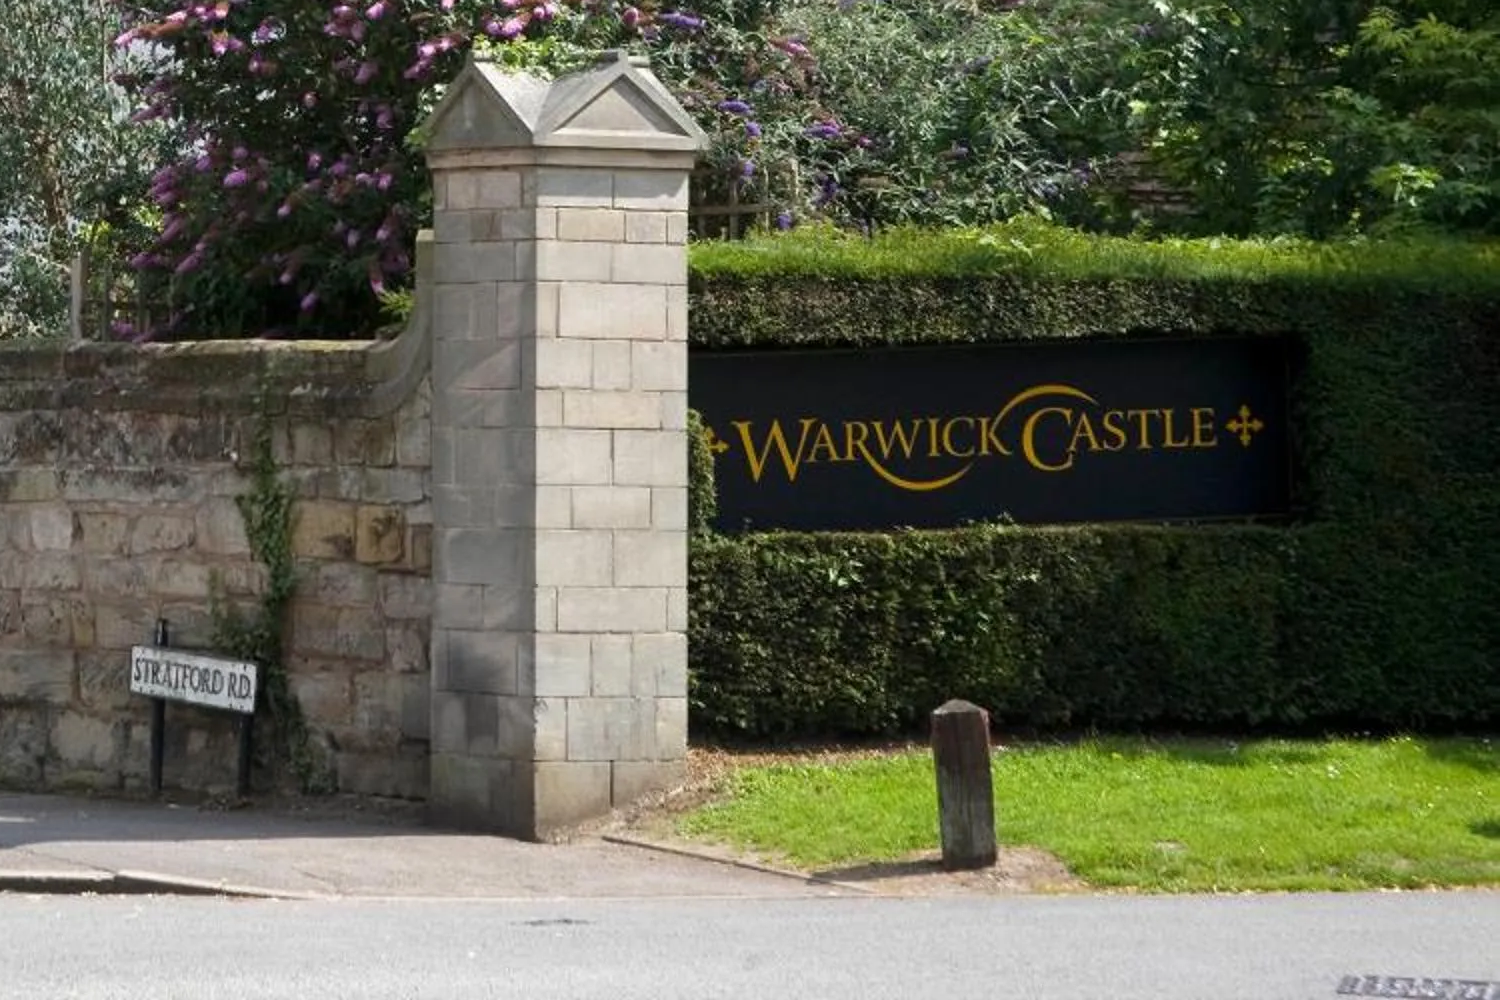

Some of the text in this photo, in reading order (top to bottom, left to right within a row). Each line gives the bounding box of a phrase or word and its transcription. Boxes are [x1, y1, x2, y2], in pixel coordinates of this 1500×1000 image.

[732, 407, 1218, 490] WARWICK CASTLE
[134, 657, 224, 695] STRATFORD
